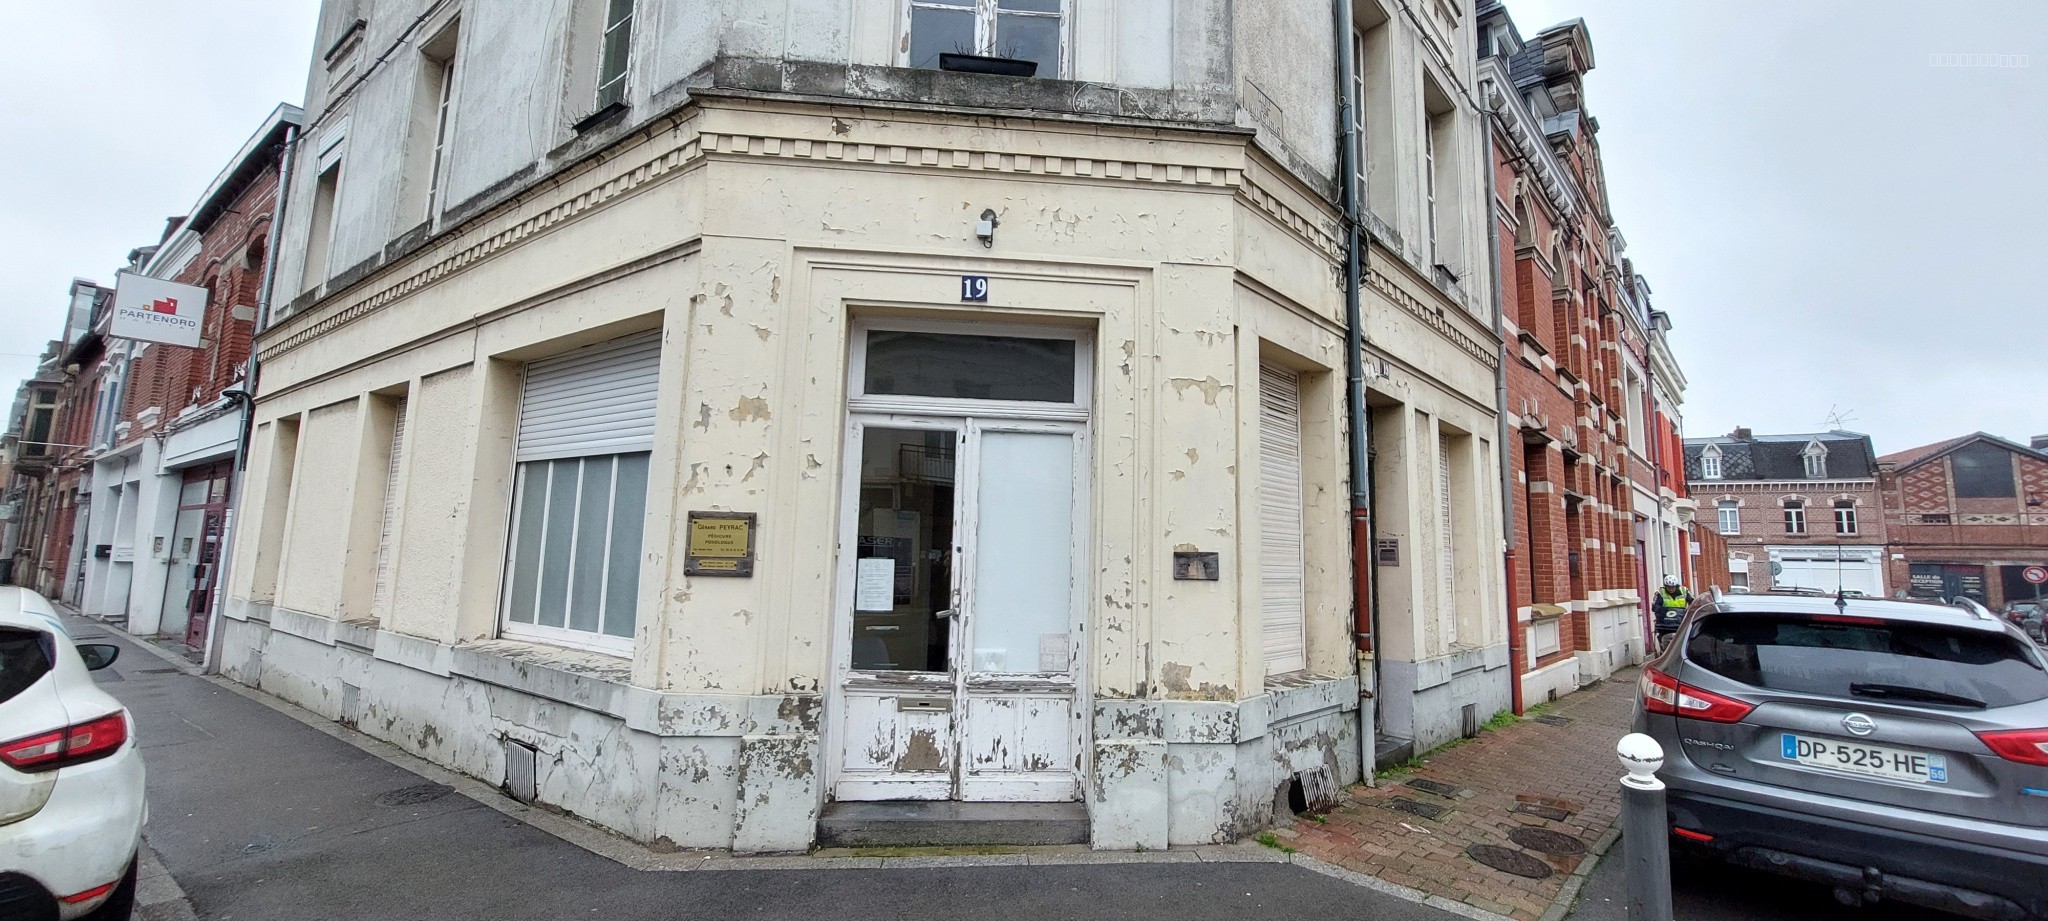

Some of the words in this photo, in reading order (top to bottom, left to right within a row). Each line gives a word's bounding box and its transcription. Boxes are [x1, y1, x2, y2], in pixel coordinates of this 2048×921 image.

[964, 279, 987, 298] 19
[120, 308, 196, 328] PARTENORD
[1684, 738, 1735, 750] QASHQAI
[1797, 739, 1928, 776] DP-525-HE
[1930, 769, 1945, 780] 59
